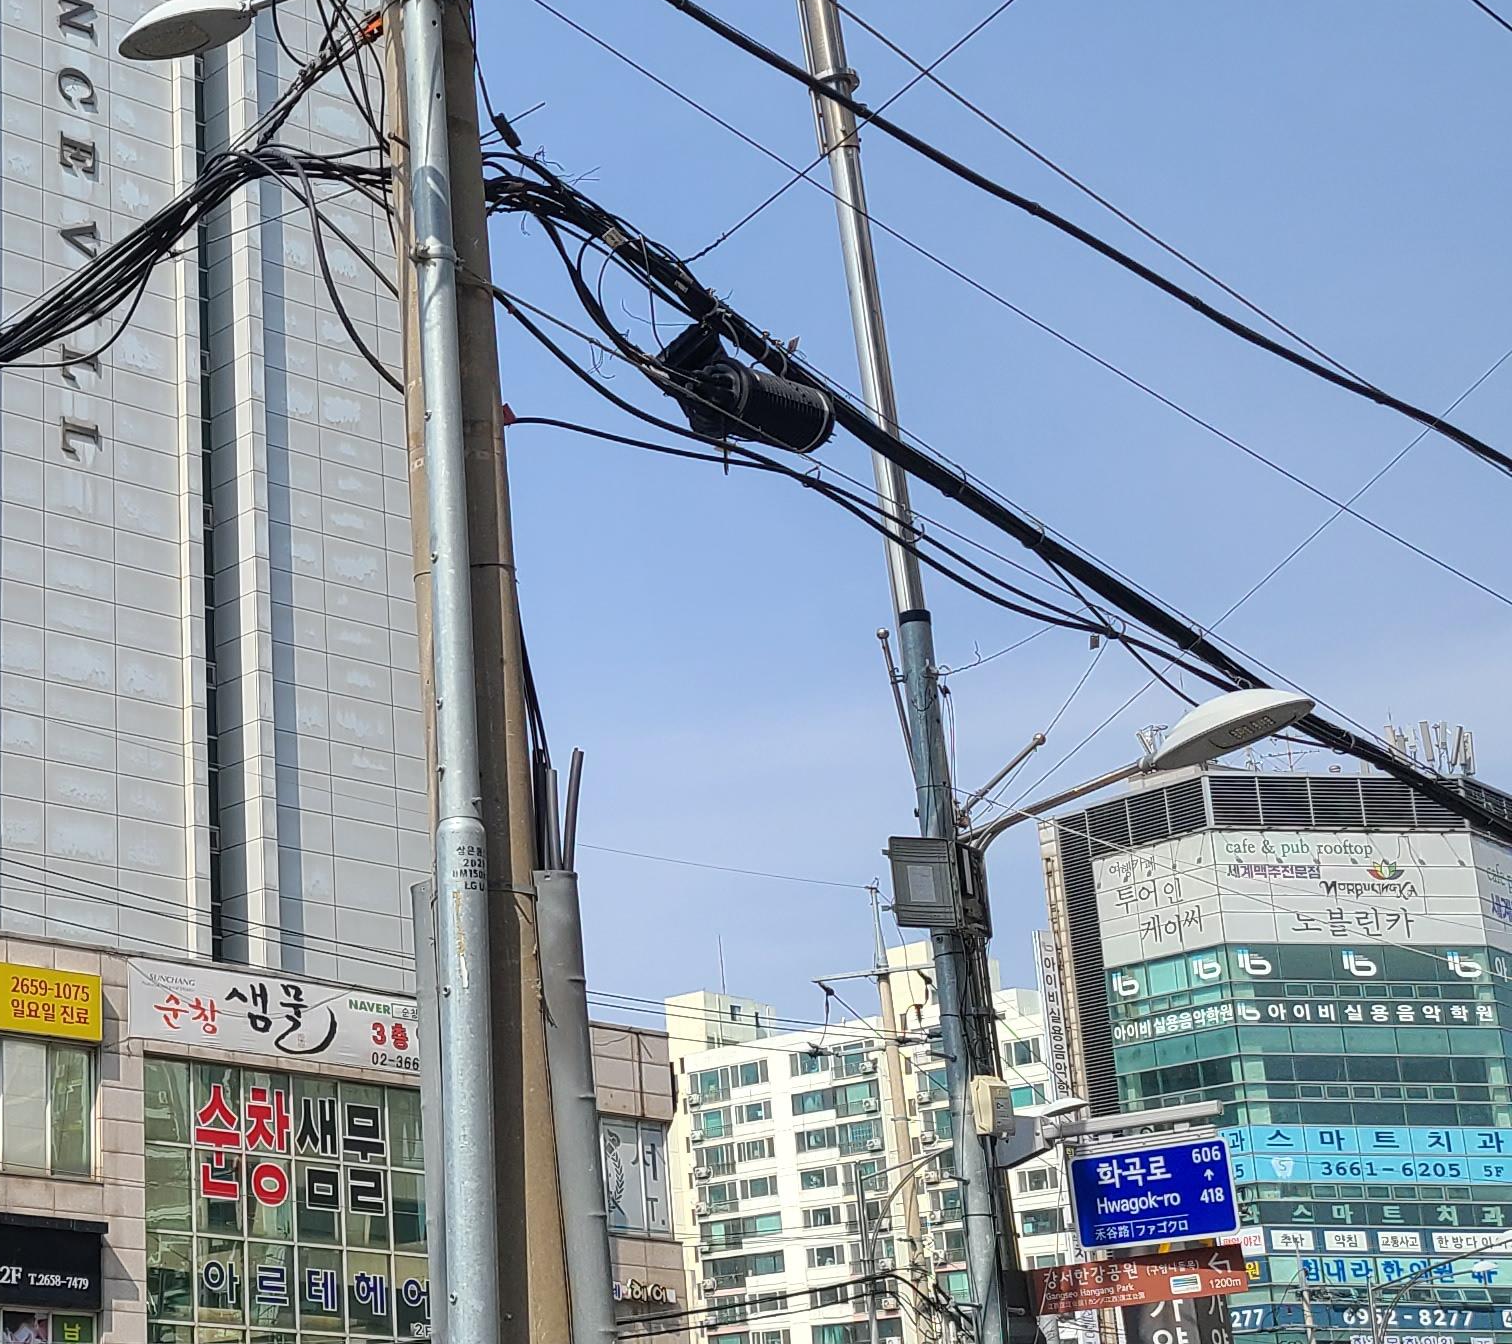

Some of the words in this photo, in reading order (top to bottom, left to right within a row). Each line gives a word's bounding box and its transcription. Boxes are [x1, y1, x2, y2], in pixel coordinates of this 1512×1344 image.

[58, 220, 102, 462] VLL
[1225, 840, 1256, 854] cafe
[1261, 839, 1276, 855] &
[1281, 838, 1310, 857] pub
[1317, 839, 1373, 857] rooftop
[1227, 863, 1321, 879] 세계맥주전문점
[1115, 877, 1184, 914] 투어인
[1291, 907, 1415, 938] 노블린카
[11, 976, 90, 1003] 2659-1075
[10, 999, 56, 1023] 일요일
[60, 1006, 90, 1025] 진료
[154, 994, 218, 1034] 순창
[225, 983, 337, 1054] 샘물
[348, 998, 391, 1015] NAVER
[371, 1022, 409, 1050] 3층
[1222, 1129, 1245, 1152] 과
[1266, 1129, 1504, 1153] 스마트치과
[1192, 1145, 1221, 1164] 606
[1096, 1155, 1172, 1189] 화곡로
[1321, 1160, 1461, 1178] 3661-6205
[1483, 1165, 1505, 1177] 5F
[1096, 1191, 1181, 1215] Hwagok-ro
[1200, 1187, 1225, 1204] 418
[1291, 1202, 1505, 1226] 스마트치과
[1094, 1224, 1130, 1241] 禾谷路
[1135, 1219, 1189, 1236] ファゴクロ
[1334, 1234, 1358, 1248] 약침
[1381, 1234, 1420, 1248] 교통사고
[0, 1265, 23, 1285] 2F
[28, 1273, 89, 1290] T.2658-7479
[1043, 1262, 1139, 1290] 강서한강공원
[1209, 1277, 1242, 1290] 1200m
[203, 1260, 430, 1319] 아르테헤어
[1046, 1292, 1078, 1302] Gangseo
[1080, 1286, 1114, 1298] Hangang
[1116, 1283, 1135, 1293] Park
